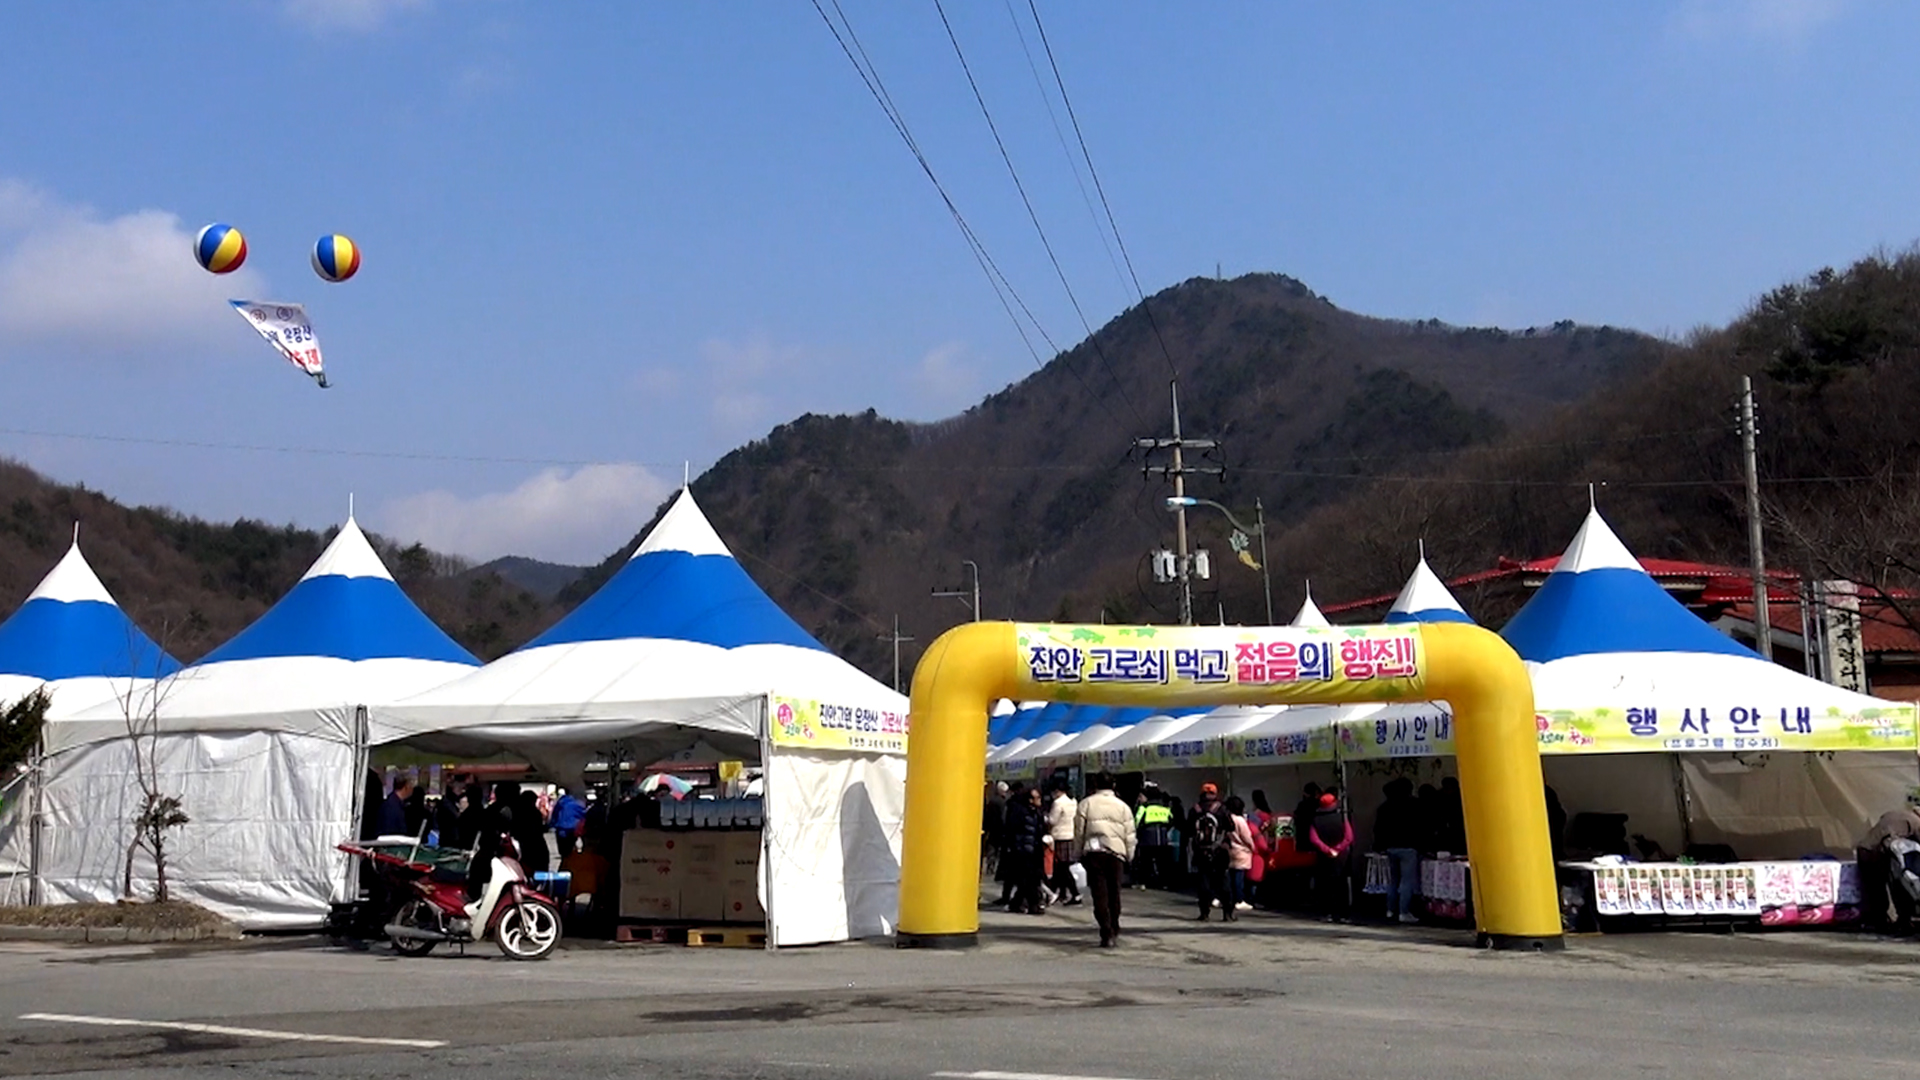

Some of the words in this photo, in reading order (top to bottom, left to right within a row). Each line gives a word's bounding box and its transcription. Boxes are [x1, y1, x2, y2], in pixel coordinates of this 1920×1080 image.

[1030, 646, 1083, 682] 진안
[1088, 649, 1167, 684] 고로쇠
[1175, 648, 1229, 683] 먹고
[1234, 641, 1333, 682] 젊음의
[1340, 637, 1418, 680] 행진!
